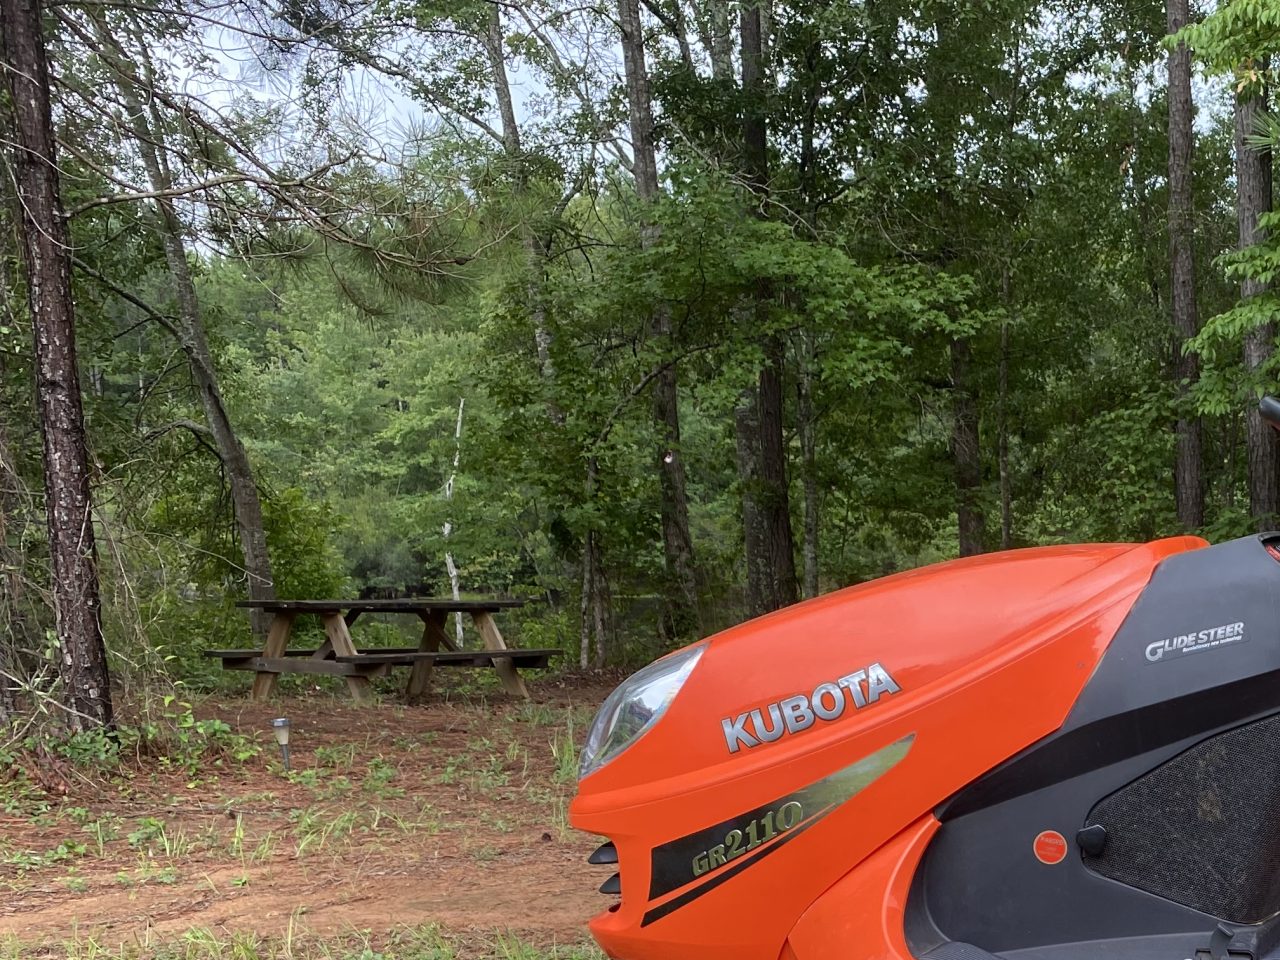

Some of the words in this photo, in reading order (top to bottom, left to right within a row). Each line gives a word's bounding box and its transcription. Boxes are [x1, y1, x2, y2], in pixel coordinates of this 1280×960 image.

[1145, 632, 1197, 661] GLIDE
[1198, 621, 1245, 644] STEER
[720, 662, 902, 753] KUBOTA
[692, 801, 804, 877] GR2110
